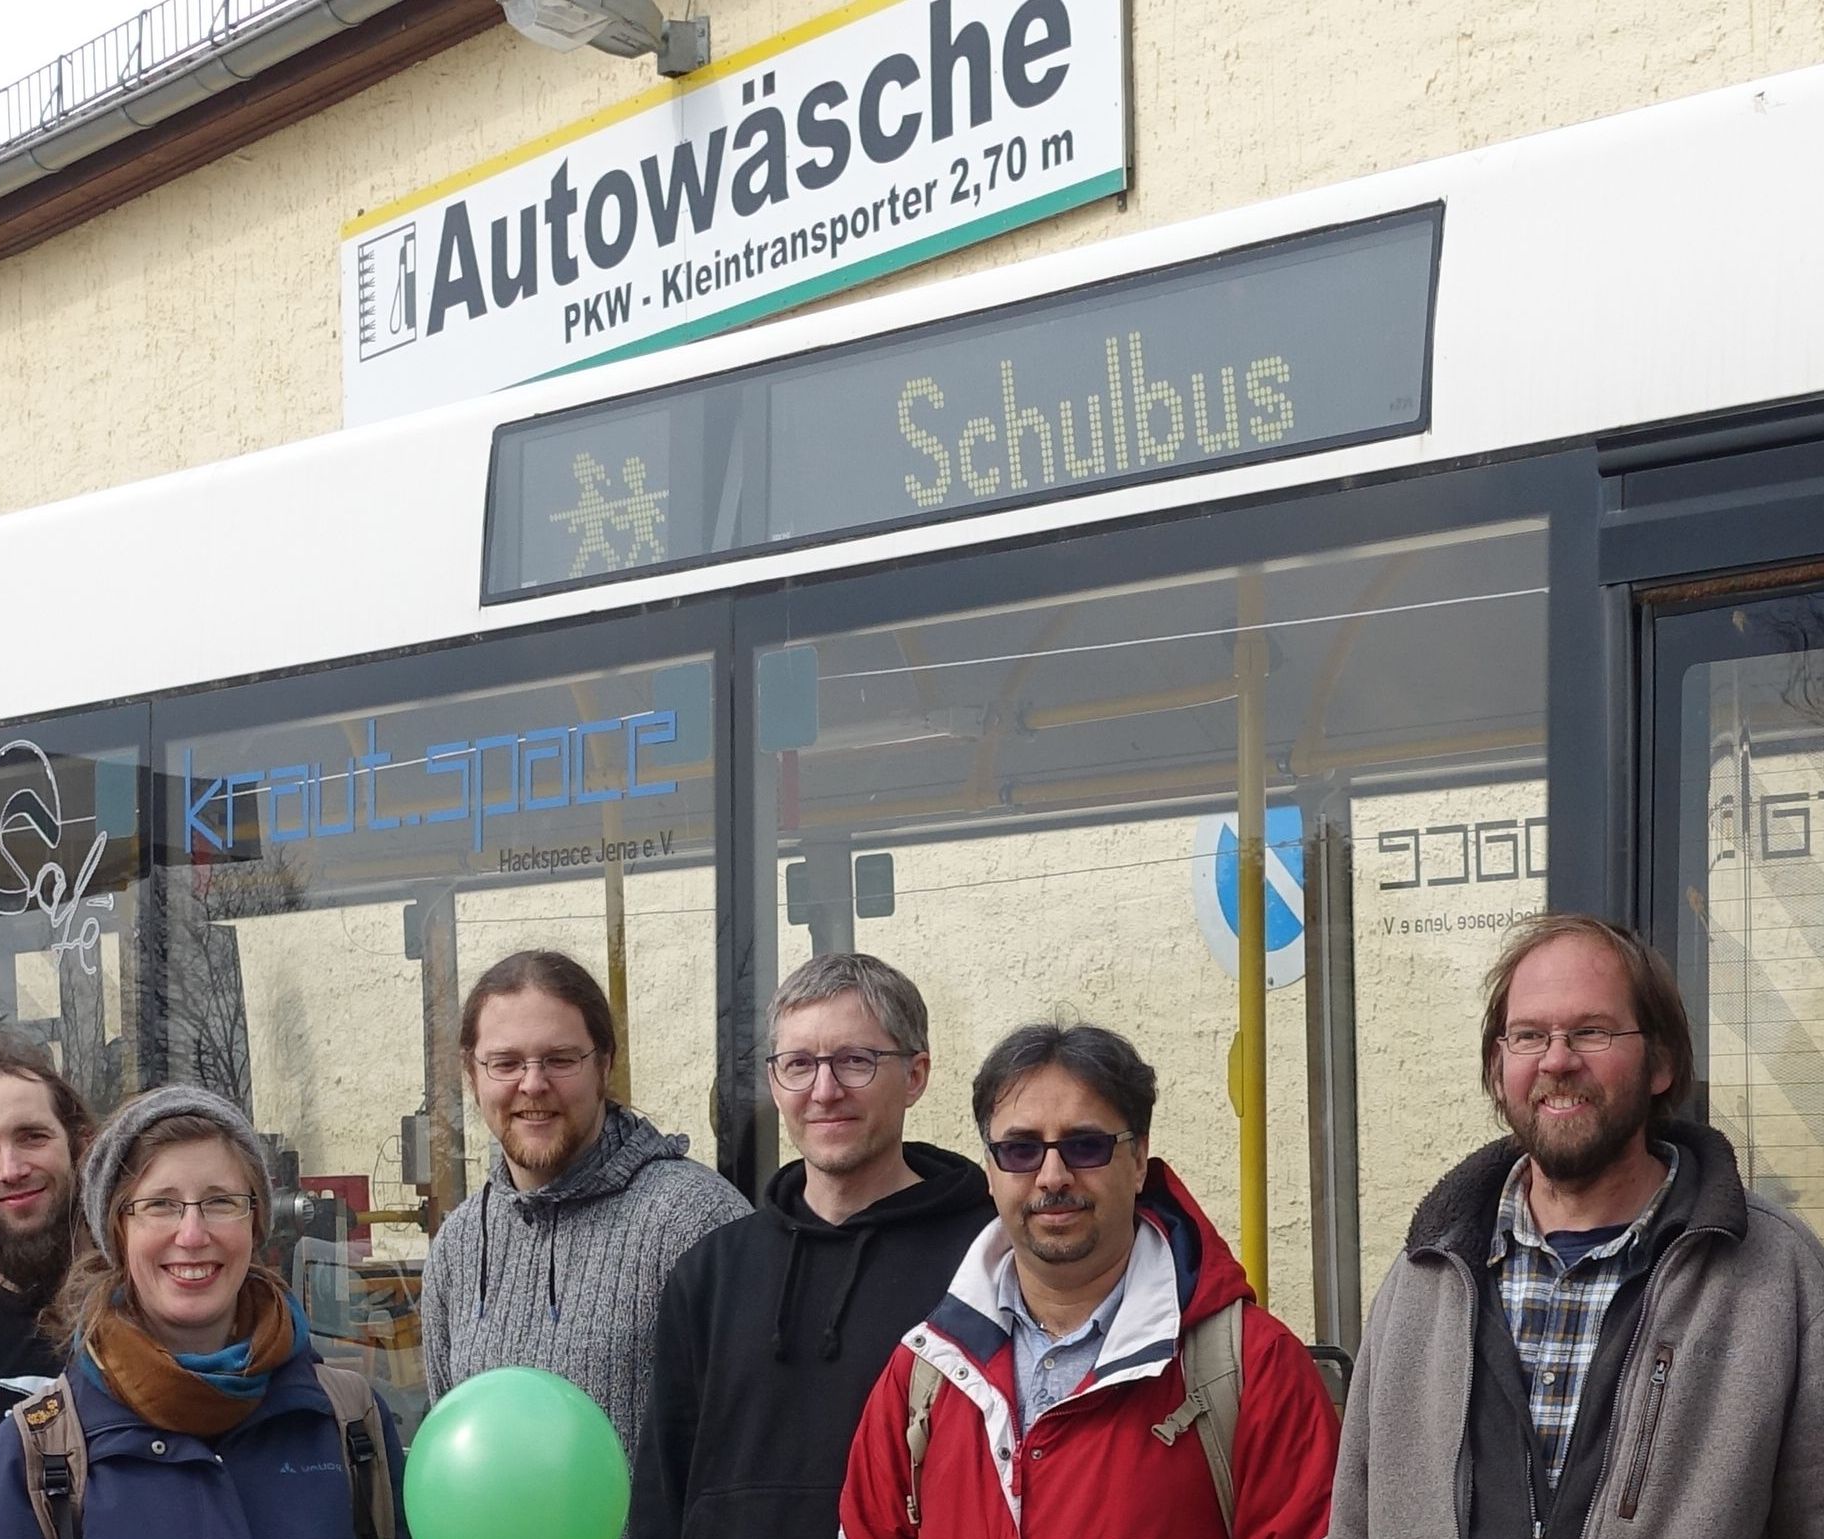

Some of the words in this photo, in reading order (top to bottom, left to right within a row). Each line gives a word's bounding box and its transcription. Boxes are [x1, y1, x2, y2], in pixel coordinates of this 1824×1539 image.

[427, 0, 1072, 336] Autowäsche
[564, 282, 633, 344] PKW
[661, 175, 938, 309] Kleintransporter
[949, 134, 1028, 206] 2,70
[1041, 128, 1076, 172] m
[896, 329, 1295, 508] Schulbus
[184, 710, 678, 853] kraut.space
[499, 846, 591, 874] Hackspace
[595, 838, 637, 863] Jena
